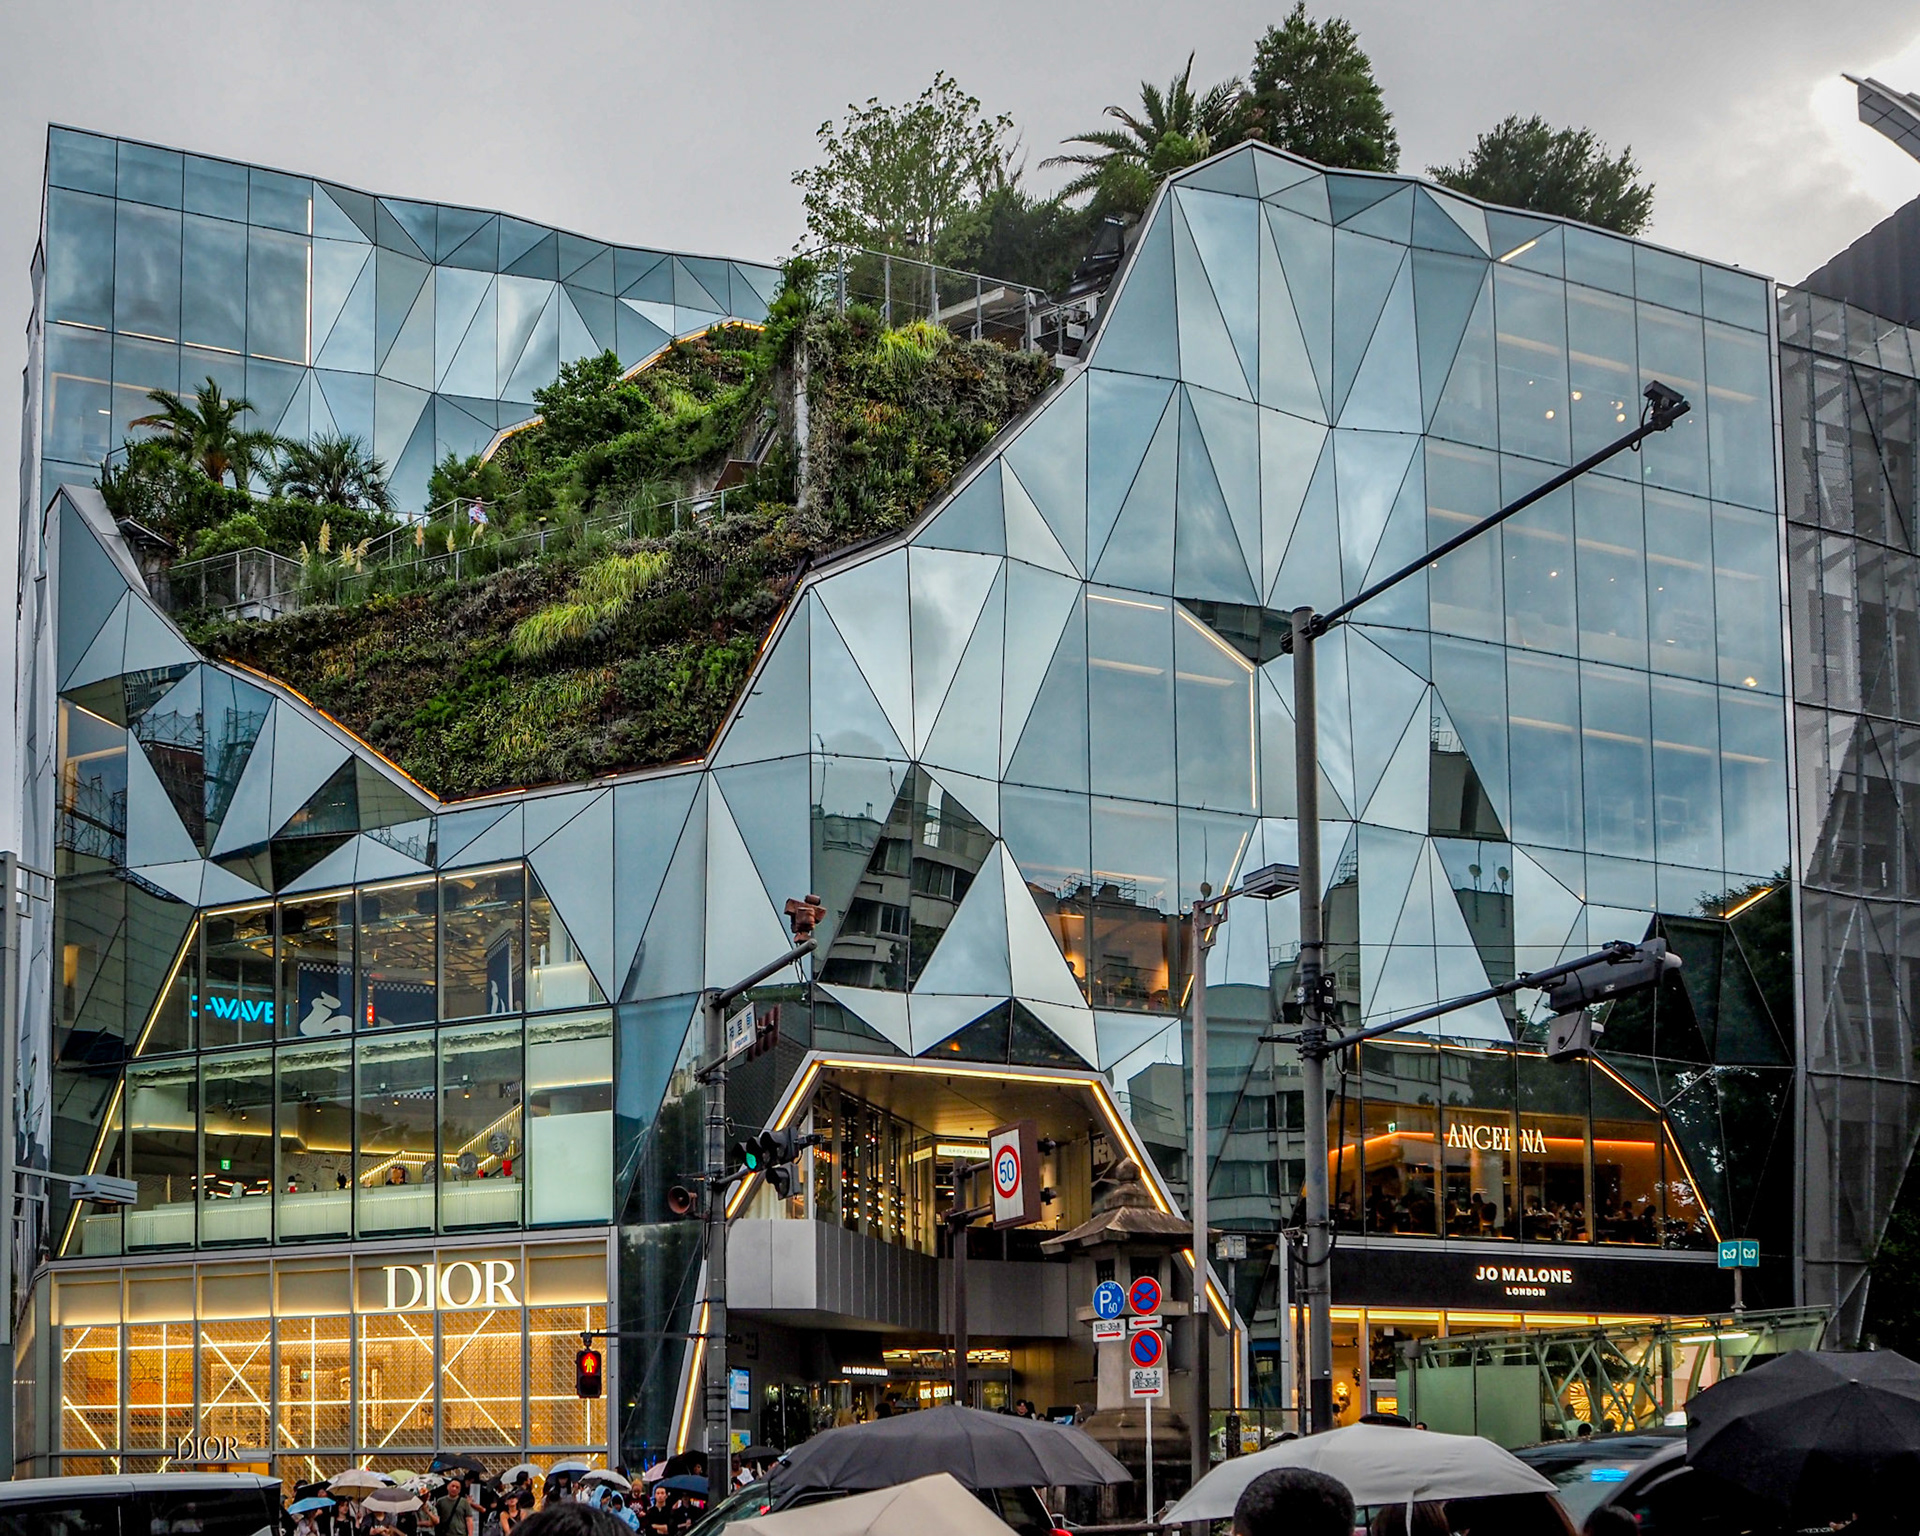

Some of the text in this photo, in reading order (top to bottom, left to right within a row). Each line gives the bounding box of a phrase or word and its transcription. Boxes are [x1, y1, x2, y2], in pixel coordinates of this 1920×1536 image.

[1447, 1122, 1548, 1154] ANGELNA
[999, 1160, 1015, 1184] 50
[382, 1259, 523, 1311] DIOR
[1475, 1266, 1573, 1284] JO MALONE
[1099, 1290, 1113, 1315] P
[1505, 1287, 1546, 1297] LONDON
[1107, 1301, 1118, 1314] 60
[174, 1436, 241, 1461] DIOR
